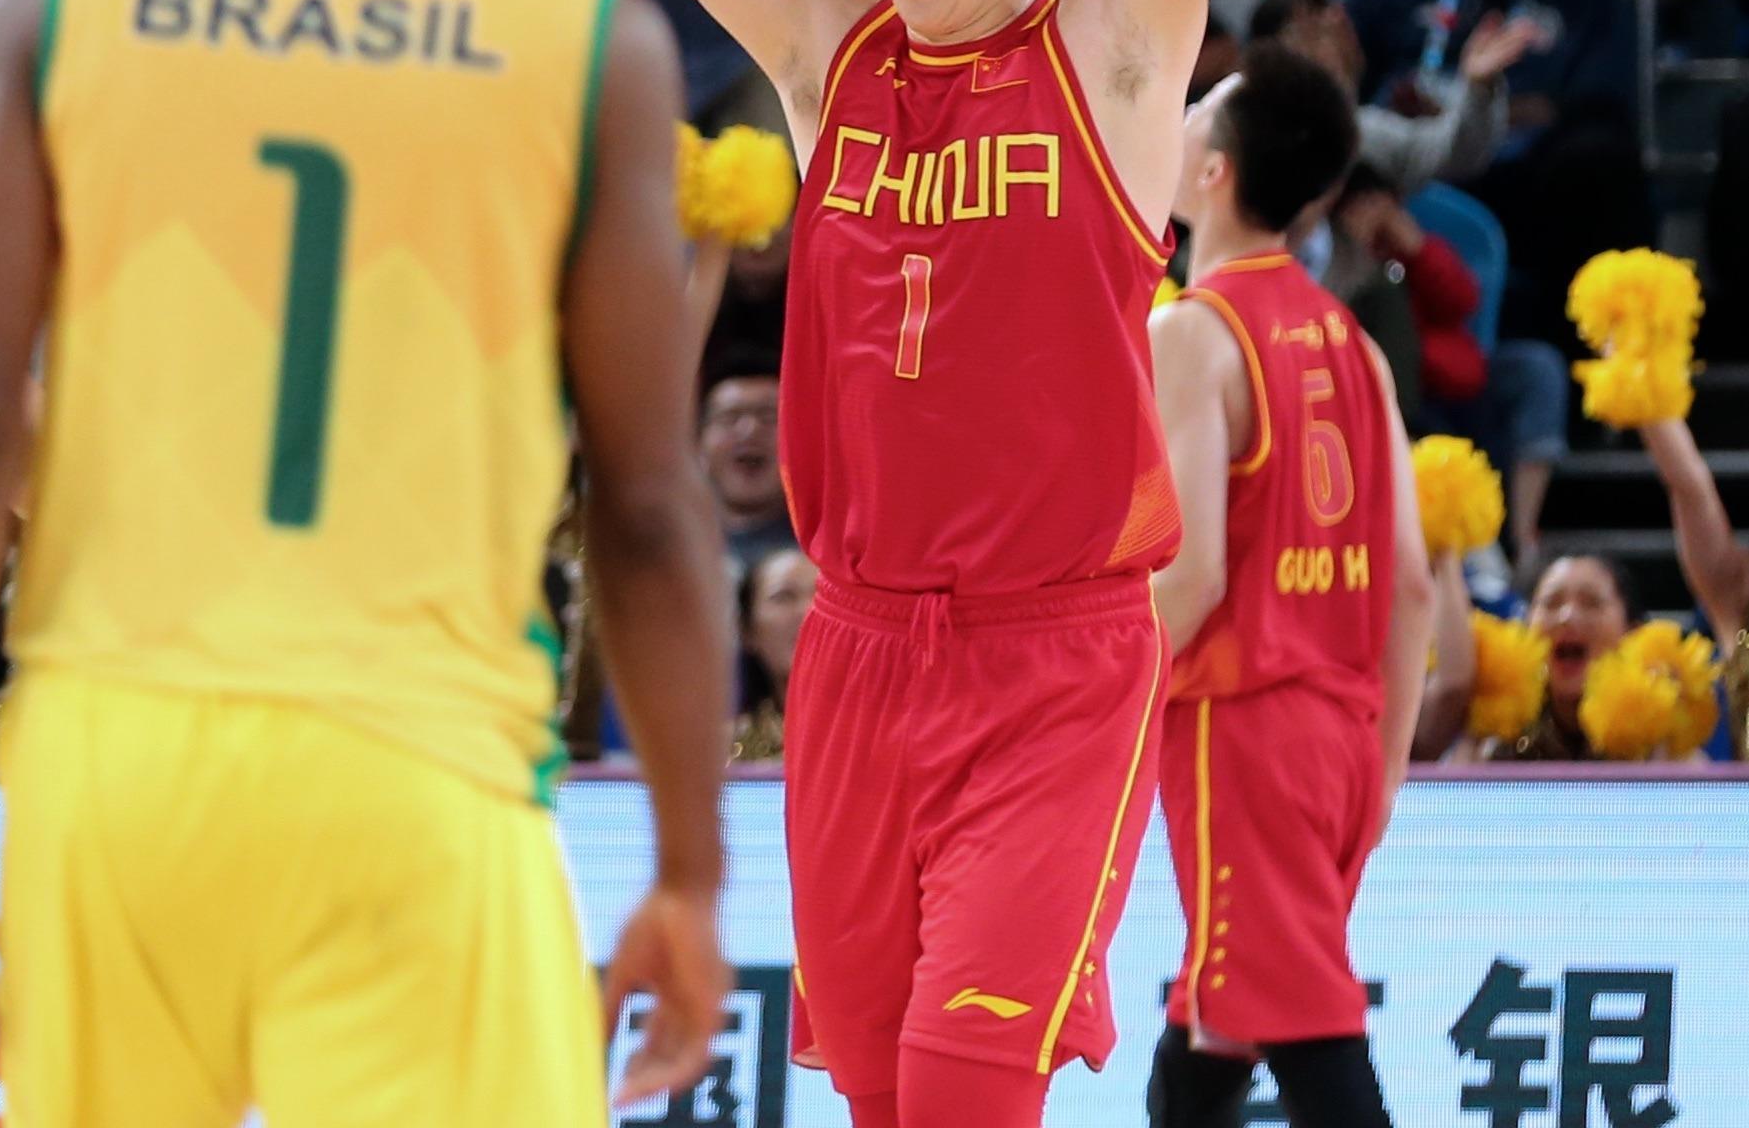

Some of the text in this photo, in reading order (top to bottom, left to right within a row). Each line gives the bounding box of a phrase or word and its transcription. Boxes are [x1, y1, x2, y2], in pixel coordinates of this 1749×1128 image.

[822, 125, 1060, 226] CHINA
[256, 137, 350, 528] 1
[895, 253, 933, 379] 1
[1276, 545, 1334, 595] GUO
